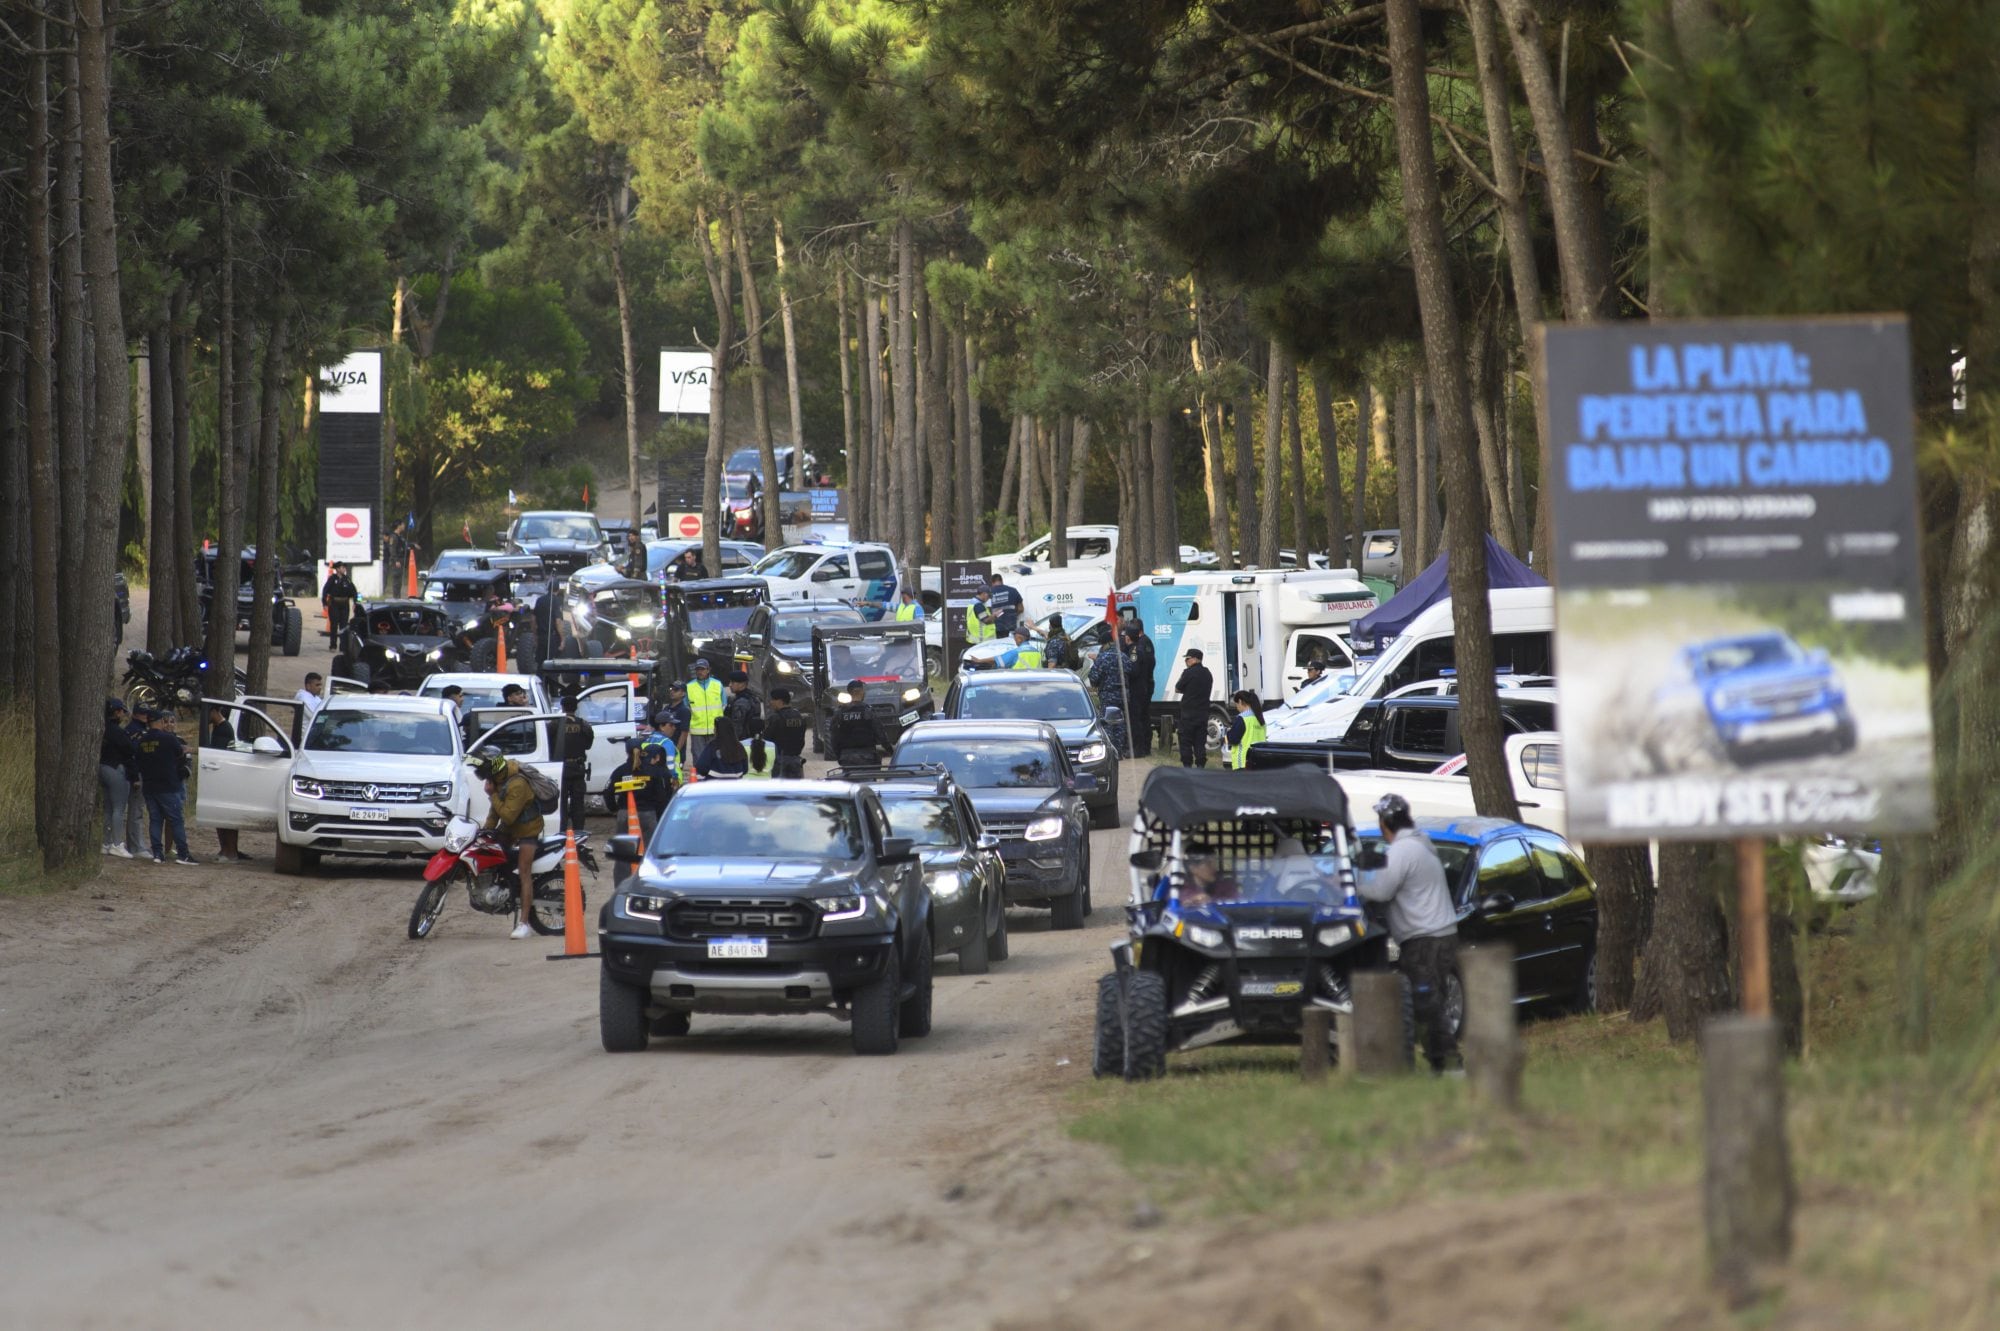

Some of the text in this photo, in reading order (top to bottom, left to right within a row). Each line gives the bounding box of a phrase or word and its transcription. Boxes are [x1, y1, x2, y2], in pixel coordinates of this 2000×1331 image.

[1631, 342, 1811, 390] LA PLAYA:
[331, 371, 367, 384] VISA
[671, 371, 707, 384] VISA
[1580, 389, 1867, 440] PERFECTA PARA
[1567, 437, 1892, 491] BAJAR UN CAMBIO
[1327, 601, 1374, 611] AMBULANCIA
[1155, 625, 1172, 634] SIES
[1724, 778, 1789, 824] SET
[1790, 777, 1881, 822] Ford
[680, 911, 803, 926] FORD
[1238, 928, 1303, 939] POLARIS
[711, 945, 764, 956] AE 840 GK
